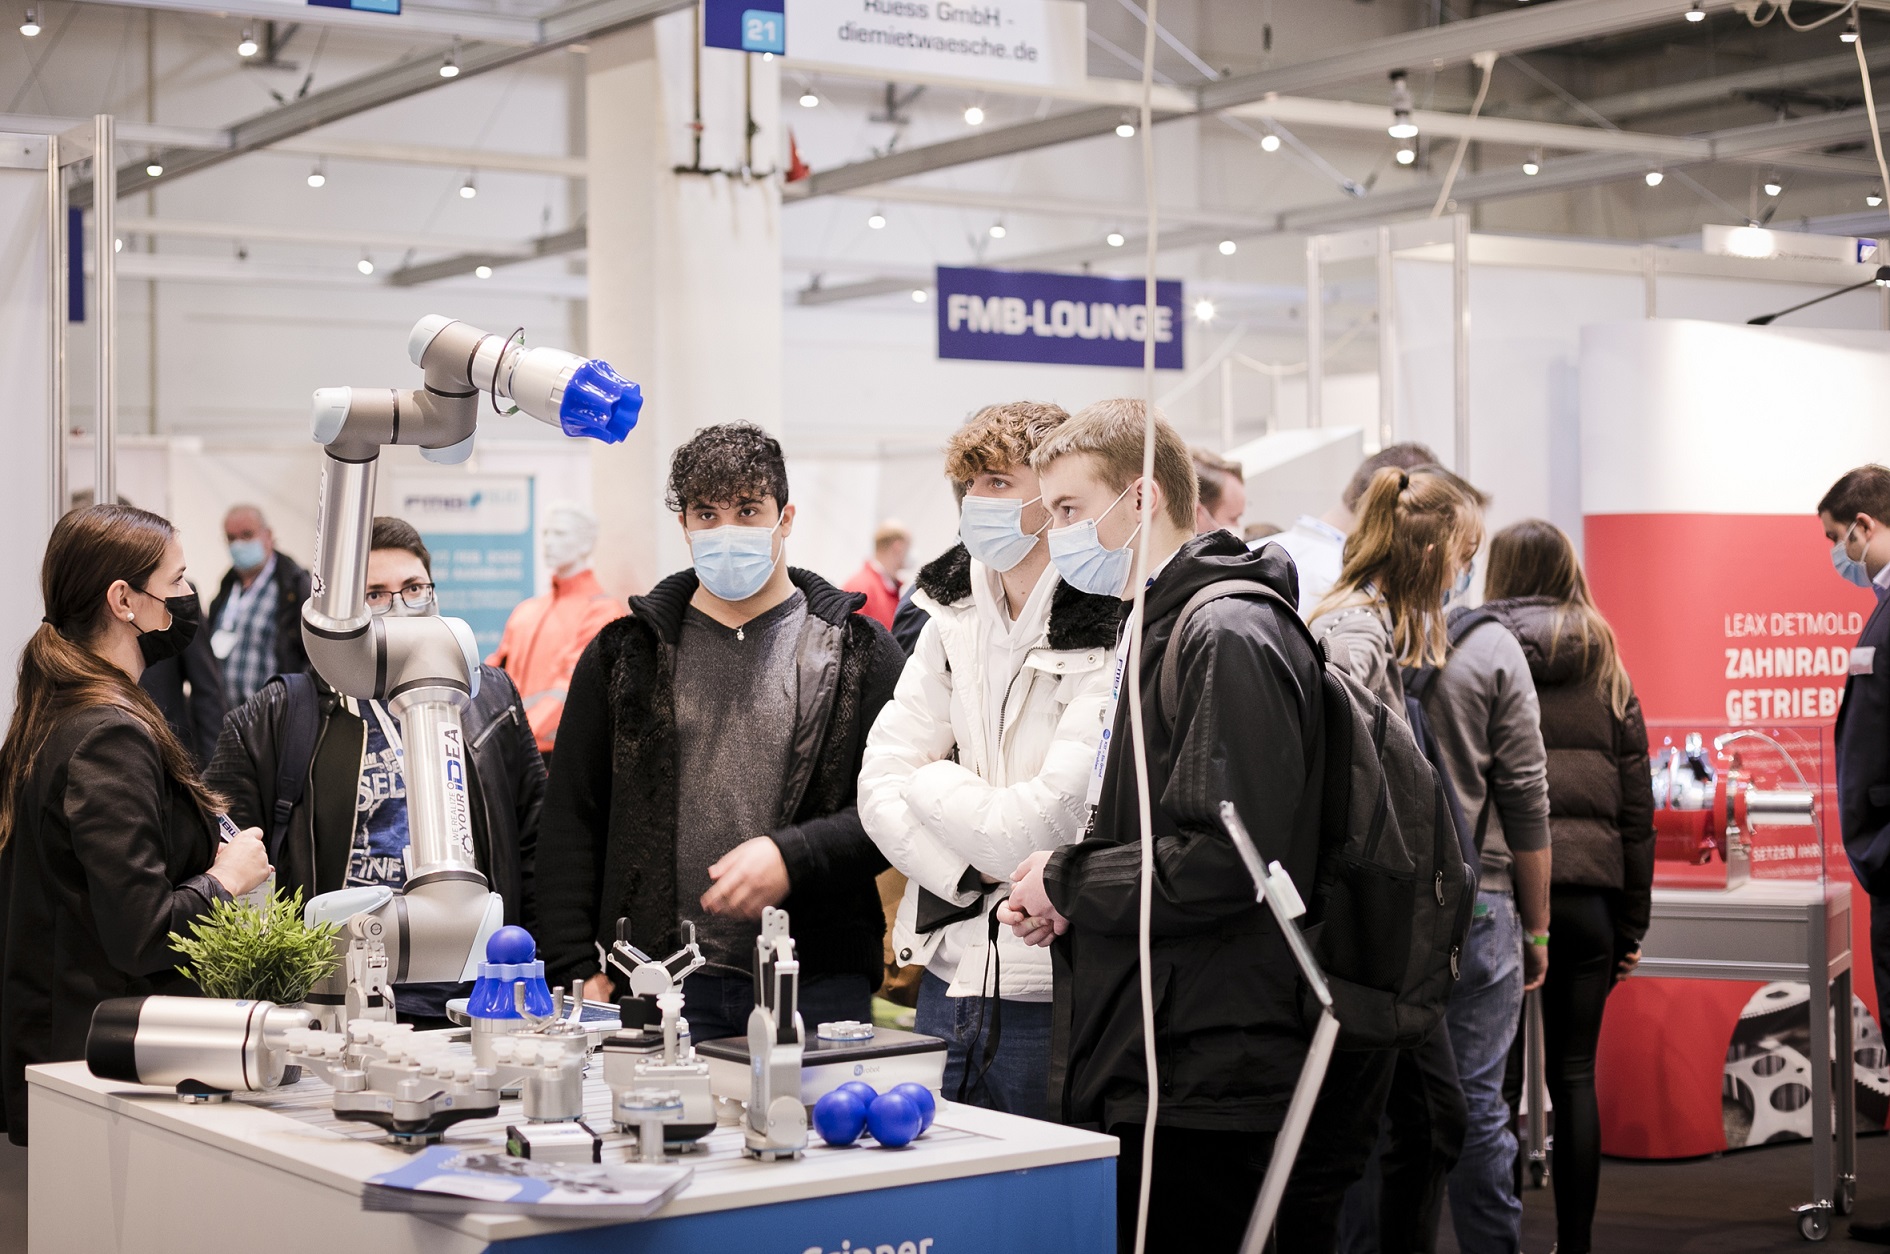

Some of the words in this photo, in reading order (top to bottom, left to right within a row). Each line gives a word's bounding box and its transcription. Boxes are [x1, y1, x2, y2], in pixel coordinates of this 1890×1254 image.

[937, 1, 1002, 27] GmbH
[746, 18, 776, 42] 21
[838, 22, 1038, 62] diemietwaesche.de
[947, 293, 1174, 343] FMB-LOUNGE
[1724, 612, 1767, 637] LEAX
[1770, 611, 1863, 637] DETMOLD
[1724, 646, 1850, 679] ZAHNRAD
[450, 792, 458, 823] REALIZE
[456, 794, 467, 831] YOUR
[451, 824, 459, 842] WE
